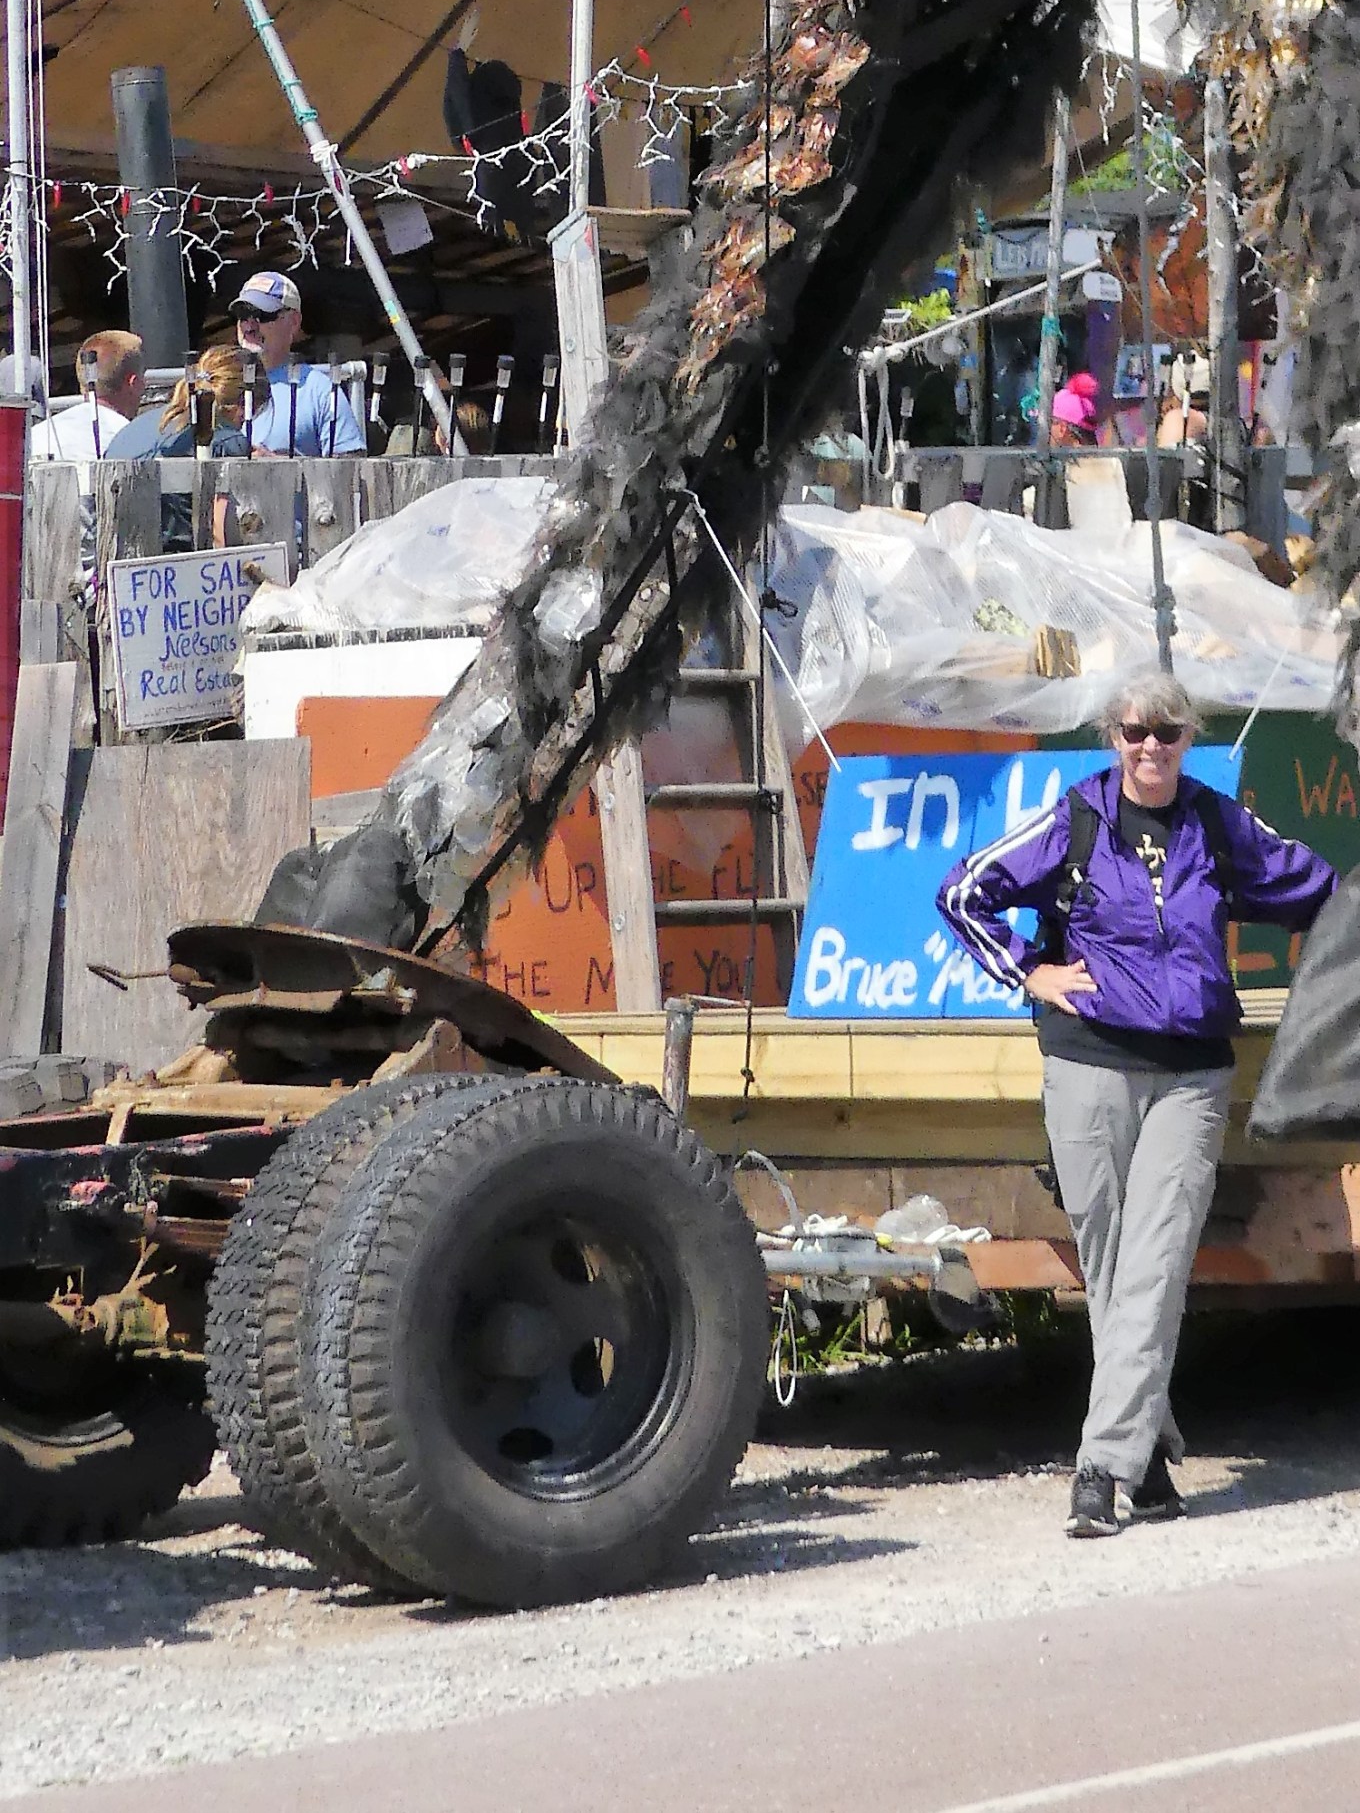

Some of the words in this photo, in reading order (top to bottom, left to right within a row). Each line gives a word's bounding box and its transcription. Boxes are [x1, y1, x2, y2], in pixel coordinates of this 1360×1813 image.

[131, 566, 177, 601] FOR
[119, 605, 148, 638] BY
[141, 669, 187, 701] Real
[195, 667, 232, 693] Esta
[803, 926, 918, 1009] Bruce
